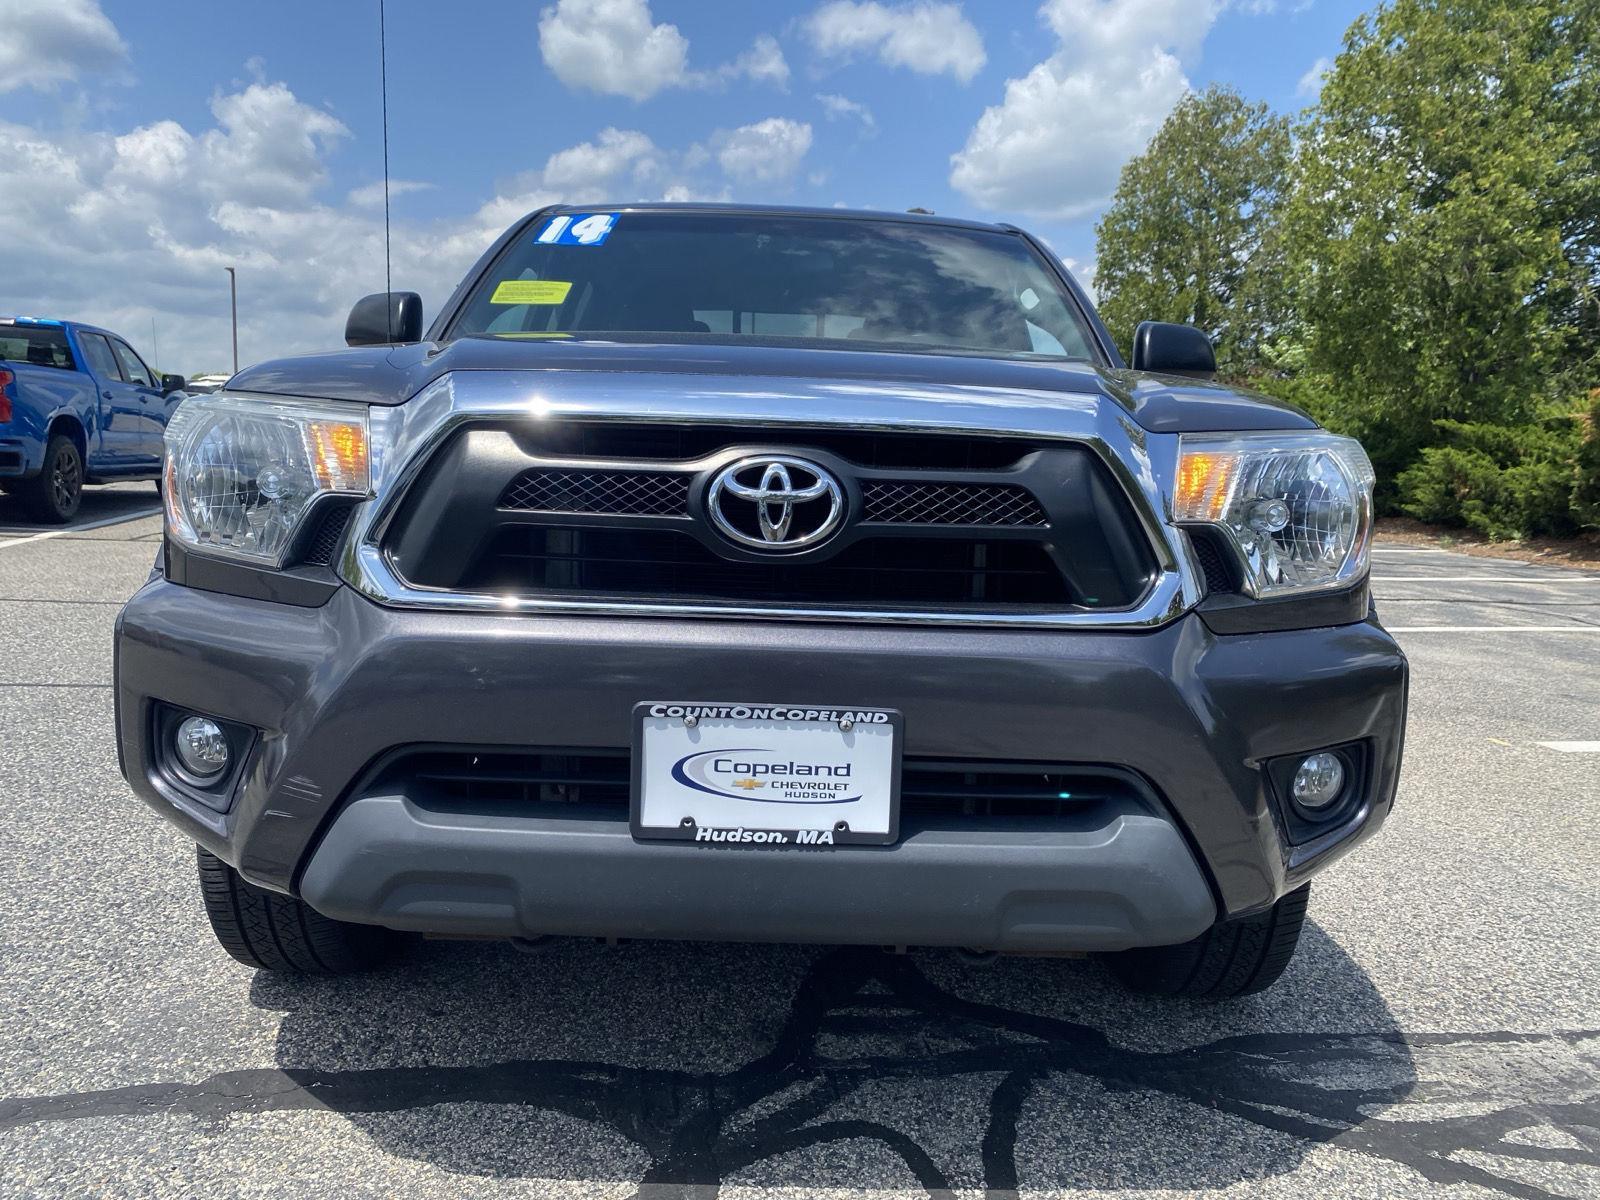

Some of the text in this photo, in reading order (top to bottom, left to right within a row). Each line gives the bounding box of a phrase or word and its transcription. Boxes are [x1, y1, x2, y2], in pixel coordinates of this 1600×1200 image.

[538, 214, 615, 243] 14
[713, 758, 851, 777] Copeland
[771, 780, 850, 791] CHEVROLET
[784, 790, 836, 799] HUDSON
[695, 827, 835, 845] Hudson, MA
